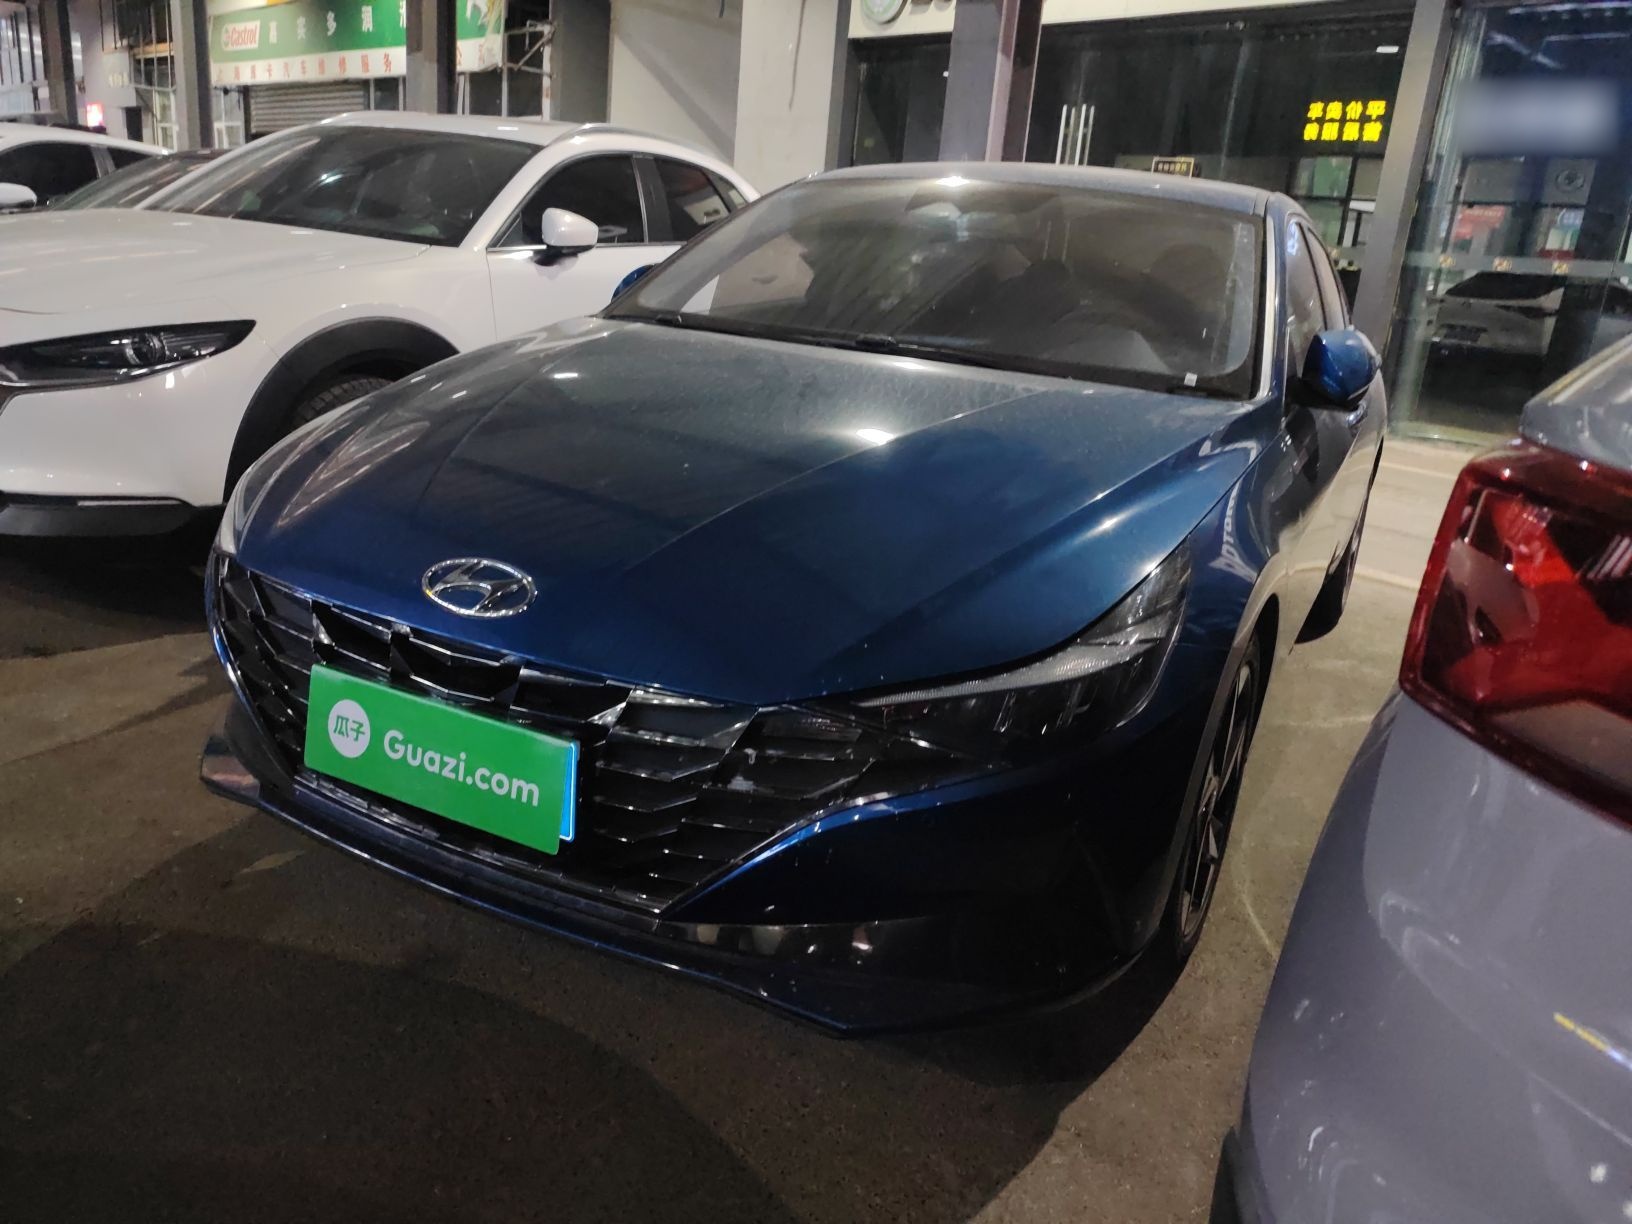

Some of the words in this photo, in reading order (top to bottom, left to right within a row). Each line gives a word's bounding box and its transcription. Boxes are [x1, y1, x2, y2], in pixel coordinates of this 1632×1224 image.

[230, 24, 258, 48] Castrol
[333, 714, 366, 742] 瓜子
[383, 729, 540, 807] Guazi.com
